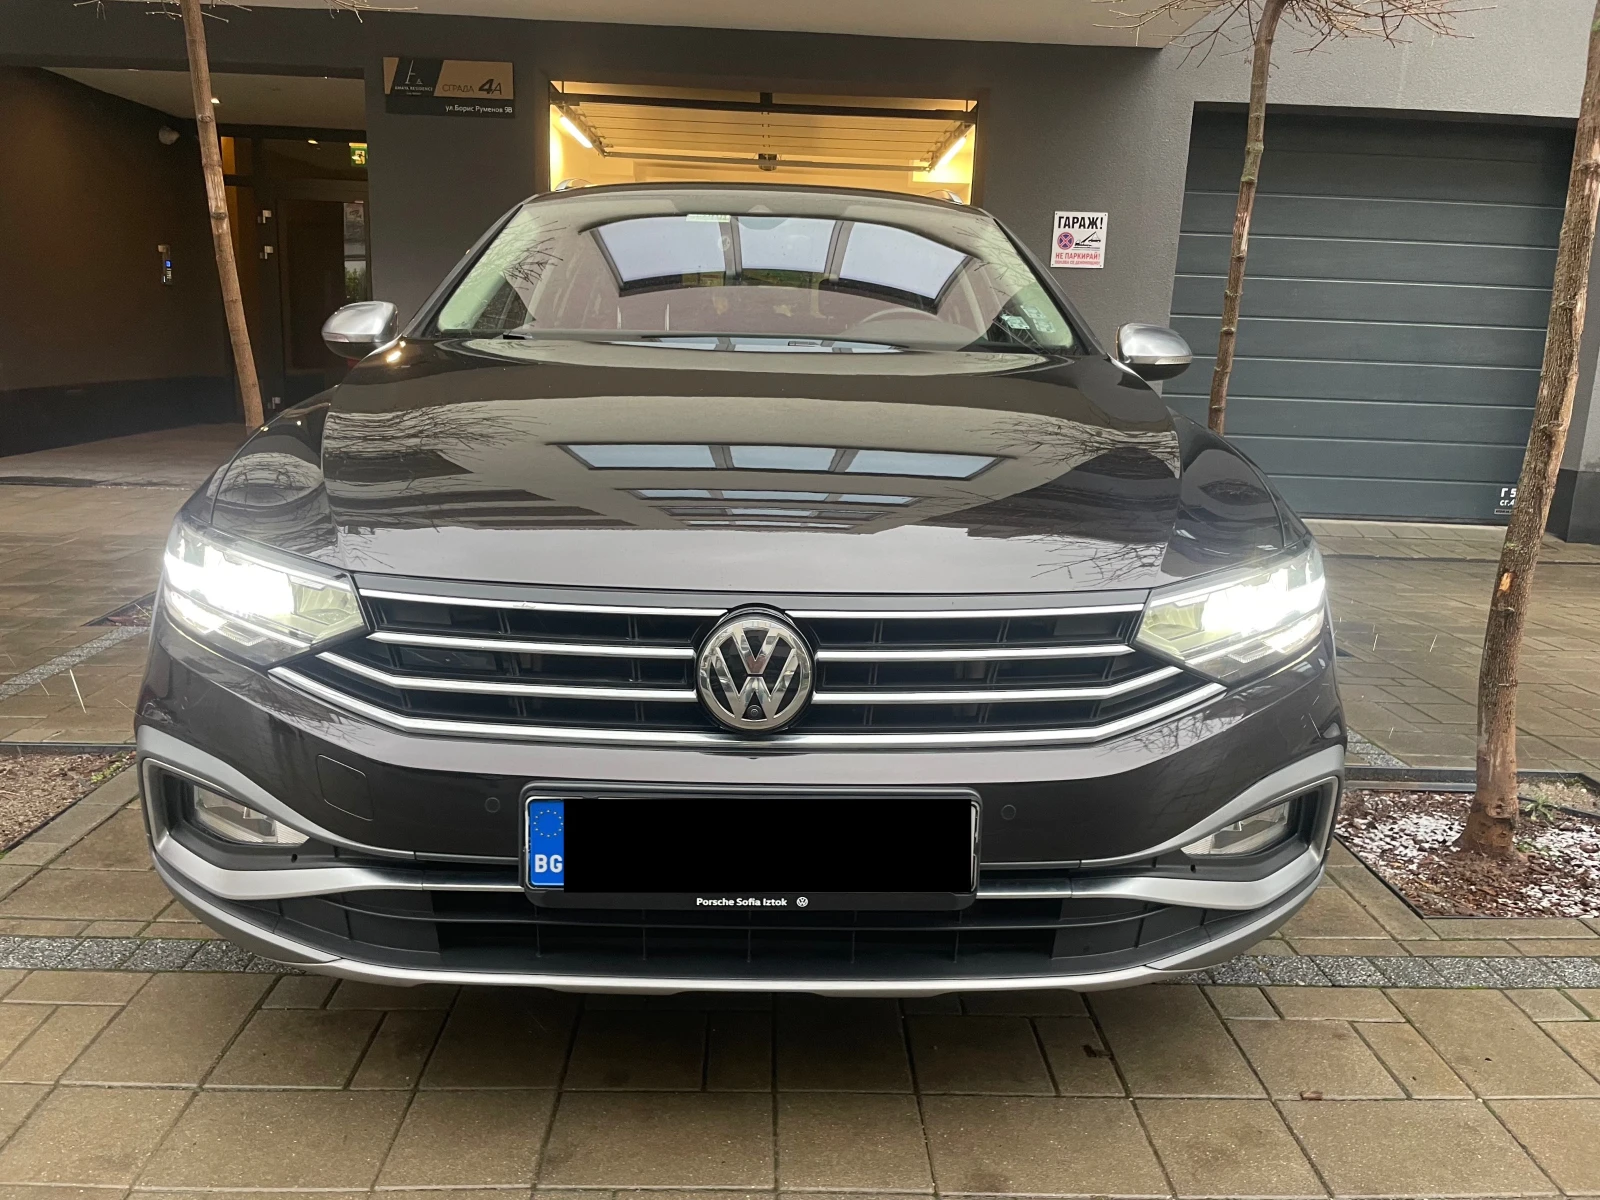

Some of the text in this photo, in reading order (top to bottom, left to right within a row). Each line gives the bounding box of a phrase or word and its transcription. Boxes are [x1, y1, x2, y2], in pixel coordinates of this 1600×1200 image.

[442, 79, 502, 95] СГРАДА 4А
[1058, 216, 1103, 229] ГАРАЖ!
[1065, 252, 1101, 260] ПАРКИРАЙ!
[1501, 488, 1508, 497] Г
[535, 854, 563, 873] BG
[696, 898, 735, 906] Porsche
[736, 898, 761, 906] Sofia
[763, 898, 787, 906] Iztok
